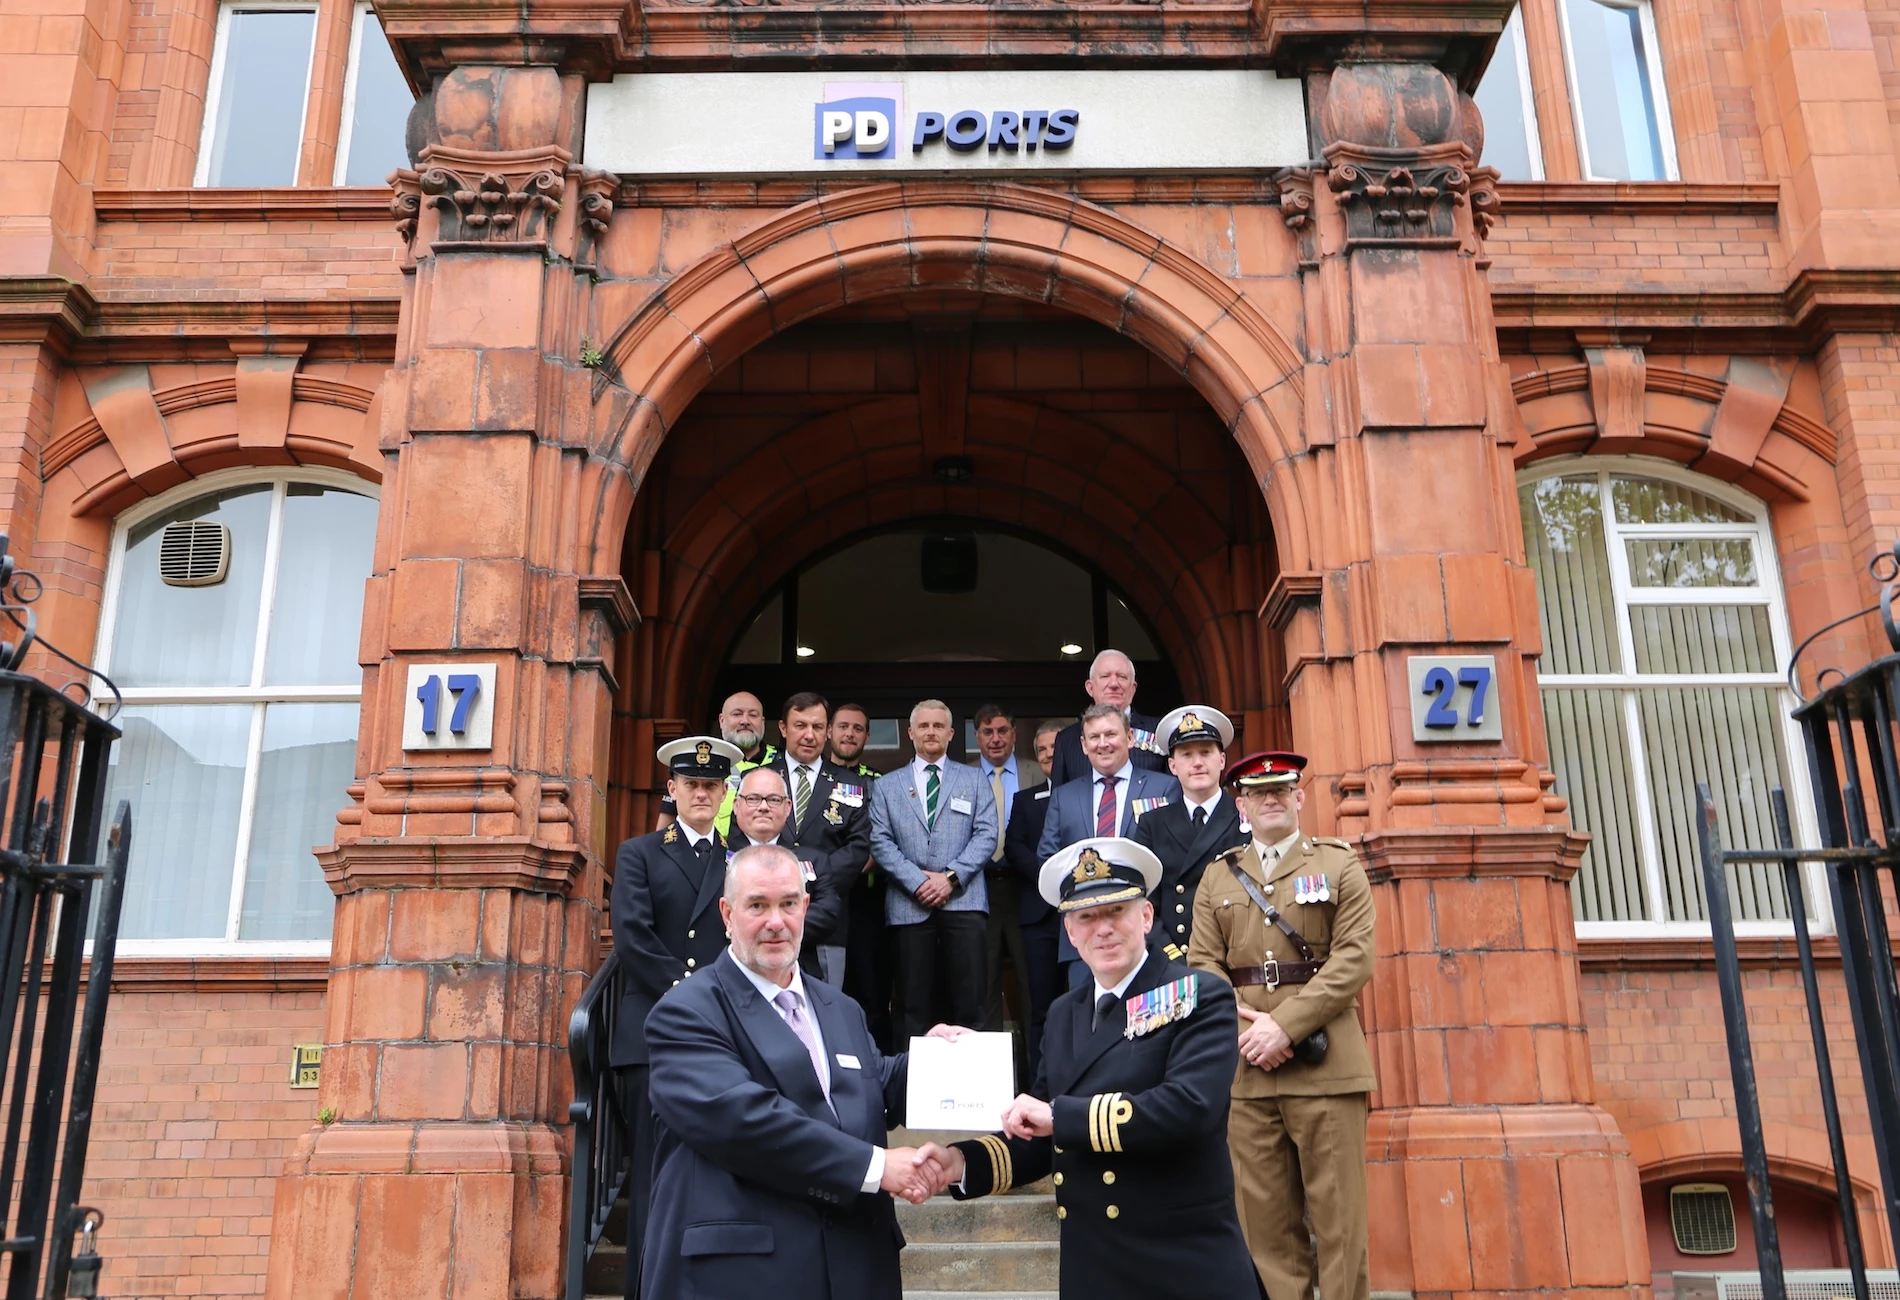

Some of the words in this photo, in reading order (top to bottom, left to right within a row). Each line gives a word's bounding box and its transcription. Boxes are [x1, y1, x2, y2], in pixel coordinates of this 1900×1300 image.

[822, 110, 890, 154] PD
[912, 109, 1080, 152] PORTS
[416, 674, 480, 735] 17
[1422, 666, 1491, 727] 27
[302, 1071, 318, 1081] 33
